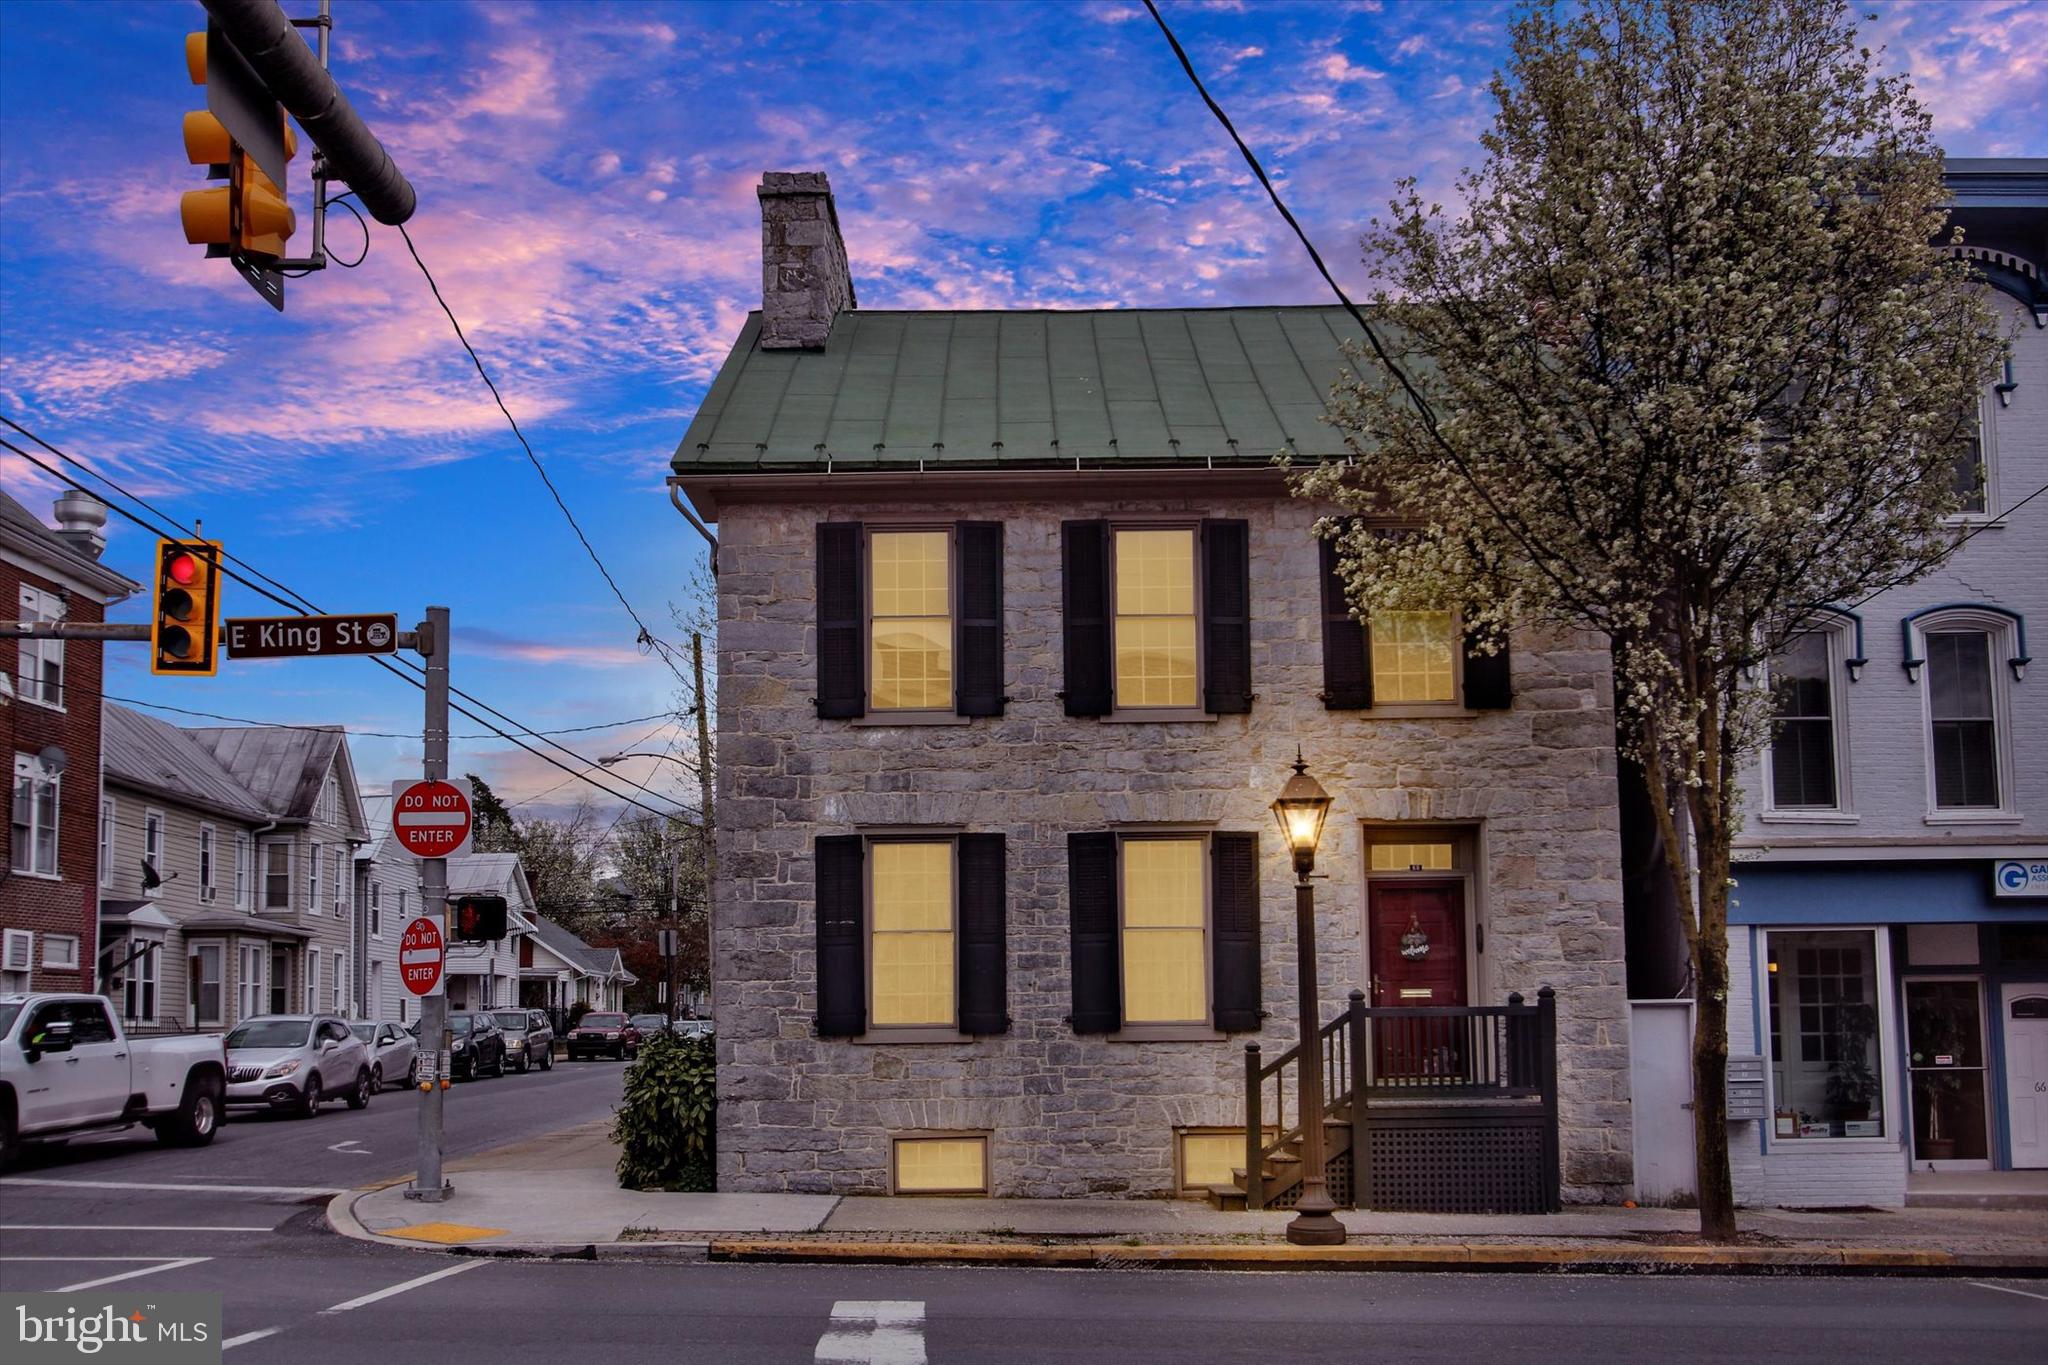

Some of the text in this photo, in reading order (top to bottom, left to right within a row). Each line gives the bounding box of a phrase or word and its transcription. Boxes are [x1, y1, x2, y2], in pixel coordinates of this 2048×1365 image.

[231, 621, 362, 652] E King St
[405, 795, 459, 808] DO NOT
[410, 830, 454, 843] ENTER
[406, 931, 437, 946] DO NOT
[408, 967, 433, 981] ENTER
[2034, 1081, 2047, 1093] 66
